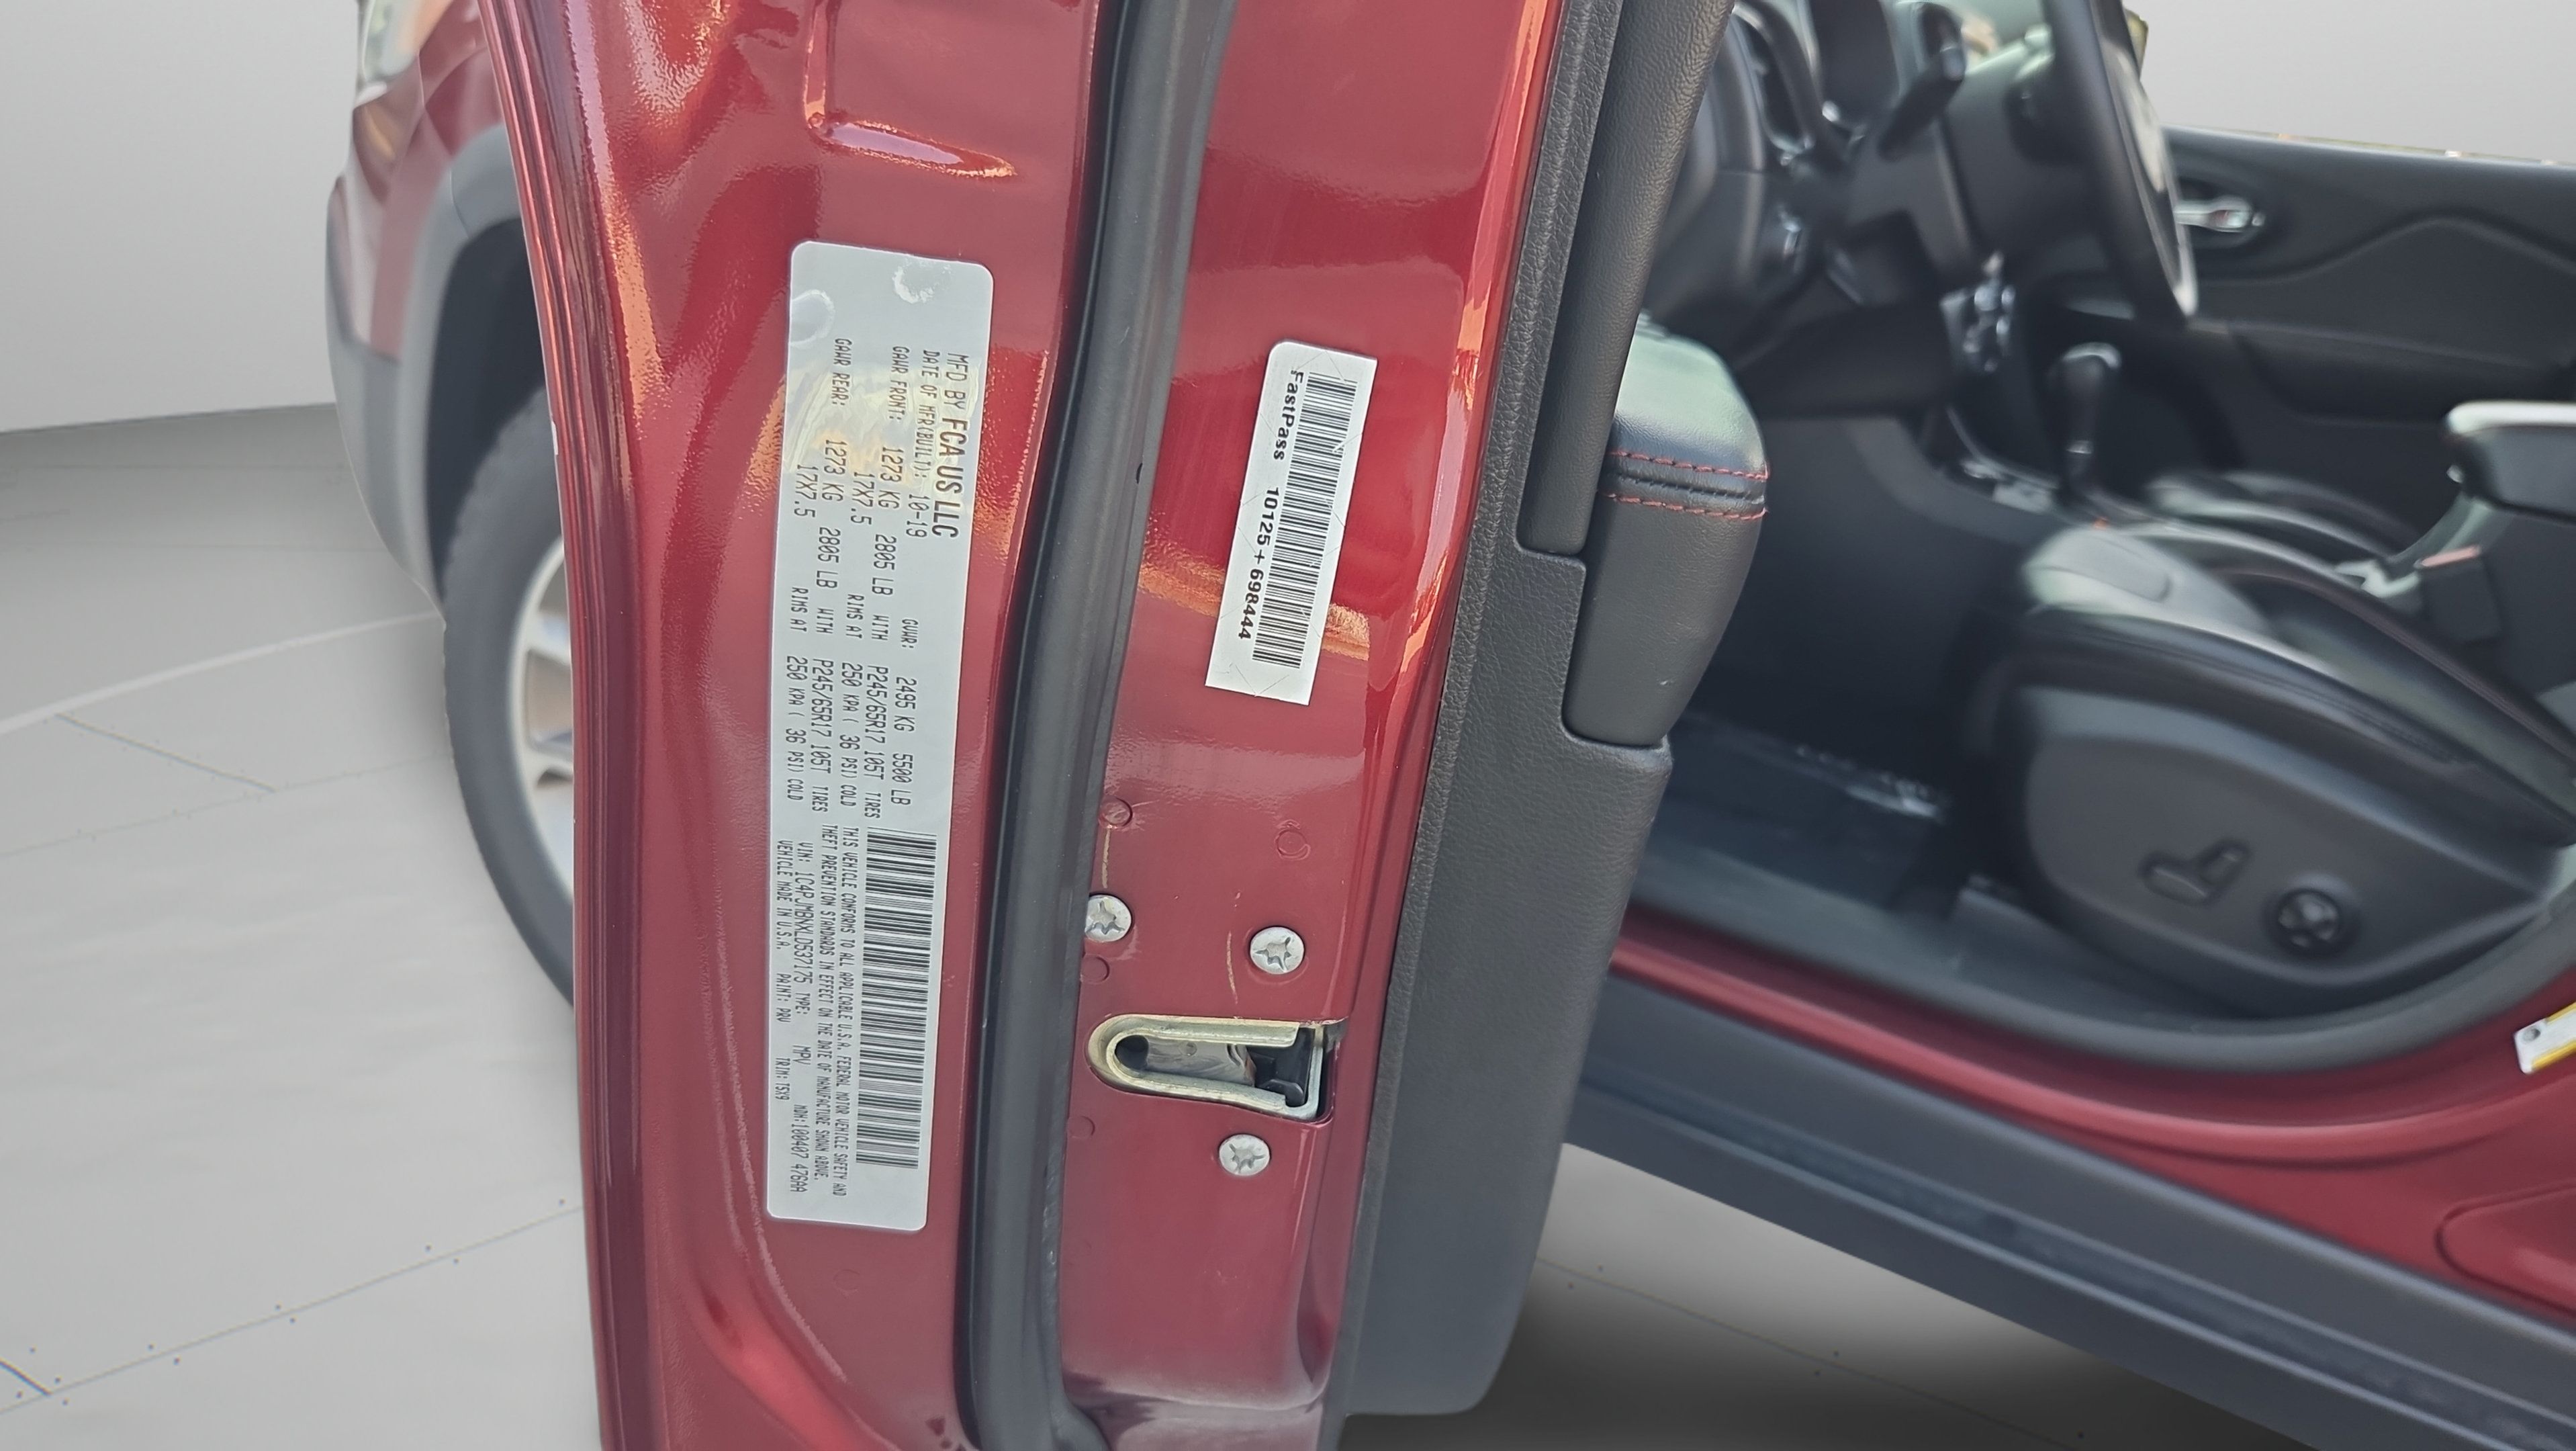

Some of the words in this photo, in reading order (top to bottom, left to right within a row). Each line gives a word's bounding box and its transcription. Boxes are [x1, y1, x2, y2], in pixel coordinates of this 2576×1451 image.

[833, 338, 852, 366] GAWR
[891, 346, 910, 373] GAWR
[921, 349, 941, 378] DATE
[946, 353, 969, 382] MFD
[831, 371, 851, 406] REAR:
[888, 380, 907, 421] FRONT:
[920, 384, 937, 399] OF
[944, 390, 966, 410] BY
[1273, 369, 1304, 460] FastPass
[939, 417, 968, 456] FCA
[823, 439, 847, 475] 1273
[880, 447, 904, 482] 1273
[794, 464, 819, 518] 17X7.5
[821, 482, 844, 502] KG
[935, 465, 964, 494] US
[850, 472, 876, 525] 17X7.5
[878, 490, 901, 509] KG
[905, 494, 930, 538] 10-19
[931, 500, 960, 538] LLC
[817, 527, 841, 564] 2805
[873, 533, 897, 570] 2805
[816, 570, 838, 588] LB
[872, 577, 894, 595] LB
[790, 586, 809, 613] RIMS
[846, 594, 865, 620] RIMS
[790, 618, 807, 632] AT
[816, 607, 834, 634] WITH
[845, 625, 863, 639] AT
[871, 614, 889, 641] WITH
[901, 619, 919, 649] GVWR:
[786, 656, 809, 680] 250
[841, 662, 863, 687] 250
[788, 687, 805, 705] KPA
[811, 658, 834, 738] P245/65R17
[842, 693, 860, 712] KPA
[864, 665, 888, 744] P245/65R17
[894, 676, 917, 709] 2495
[785, 728, 807, 744] 36
[893, 715, 915, 732] KG
[839, 734, 861, 750] 36
[787, 750, 804, 773] PSI)
[810, 744, 832, 774] 105T
[840, 756, 858, 779] PSI)
[864, 750, 885, 781] 105T
[891, 753, 913, 783] 5500
[786, 779, 804, 801] COLD
[811, 786, 829, 812] TIRES
[840, 784, 857, 807] COLD
[890, 789, 911, 805] LB
[864, 792, 882, 819] TIRES
[821, 824, 838, 850] THEFT
[842, 827, 860, 848] THIS
[776, 840, 794, 877] VEHICLE
[796, 842, 814, 863] VIN:
[820, 854, 838, 907] PREVENTION
[841, 852, 858, 889] VEHICLE
[776, 881, 793, 902] MADE
[776, 907, 792, 918] IN
[840, 893, 857, 934] CONFORMS
[776, 921, 793, 950] U.S.A.
[793, 871, 815, 984] 1C4PJMBNXLD537175
[819, 910, 836, 956] STANDARDS
[839, 939, 856, 949] TO
[819, 961, 835, 971] IN
[839, 952, 855, 967] ALL
[776, 973, 792, 1002] PAINT:
[818, 974, 835, 1004] EFFECT
[837, 971, 854, 1020] APPLICABLE
[776, 1007, 792, 1022] PRV
[794, 992, 811, 1014] TYPE:
[817, 1007, 833, 1018] ON
[817, 1022, 833, 1037] THE
[837, 1023, 853, 1051] U.S.A.
[792, 1045, 812, 1065] MPV
[817, 1039, 833, 1059] DATE
[775, 1057, 791, 1079] TRIM:
[817, 1063, 832, 1073] OF
[835, 1055, 852, 1087] FEDERAL
[815, 1075, 831, 1126] MANUFACTURE
[835, 1091, 851, 1114] MOTOR
[815, 1129, 830, 1152] SHOWN
[833, 1118, 849, 1150] VEHICLE
[790, 1163, 809, 1192] 476AA
[814, 1155, 829, 1180] ABOVE.
[833, 1153, 848, 1180] SAFETY
[832, 1182, 847, 1196] AND
